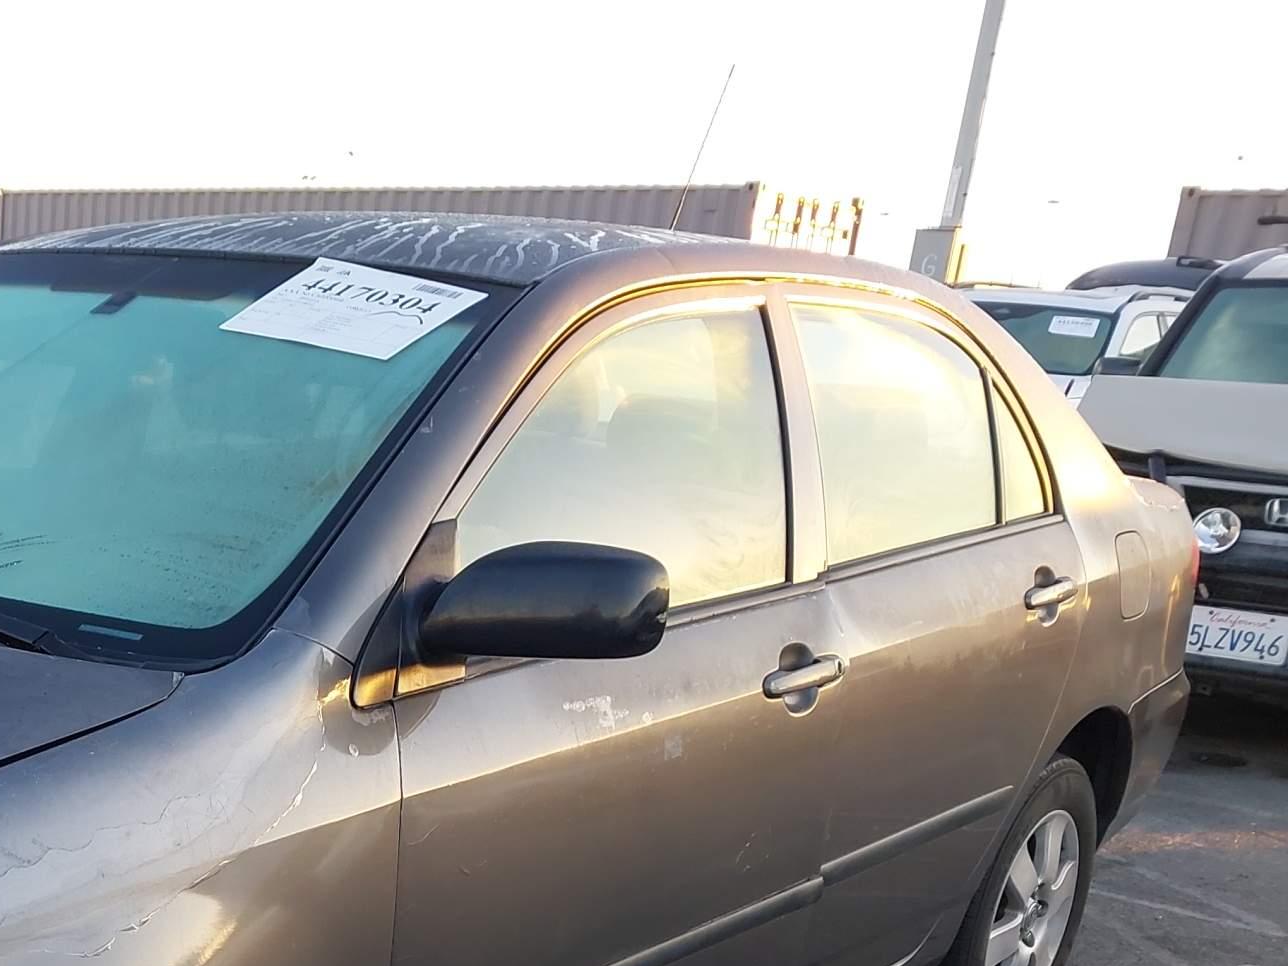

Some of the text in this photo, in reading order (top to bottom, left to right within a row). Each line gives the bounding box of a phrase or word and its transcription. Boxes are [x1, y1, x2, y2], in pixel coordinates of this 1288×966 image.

[301, 278, 441, 314] 44170304
[1209, 613, 1268, 628] California
[1188, 623, 1284, 657] 5LZV946
